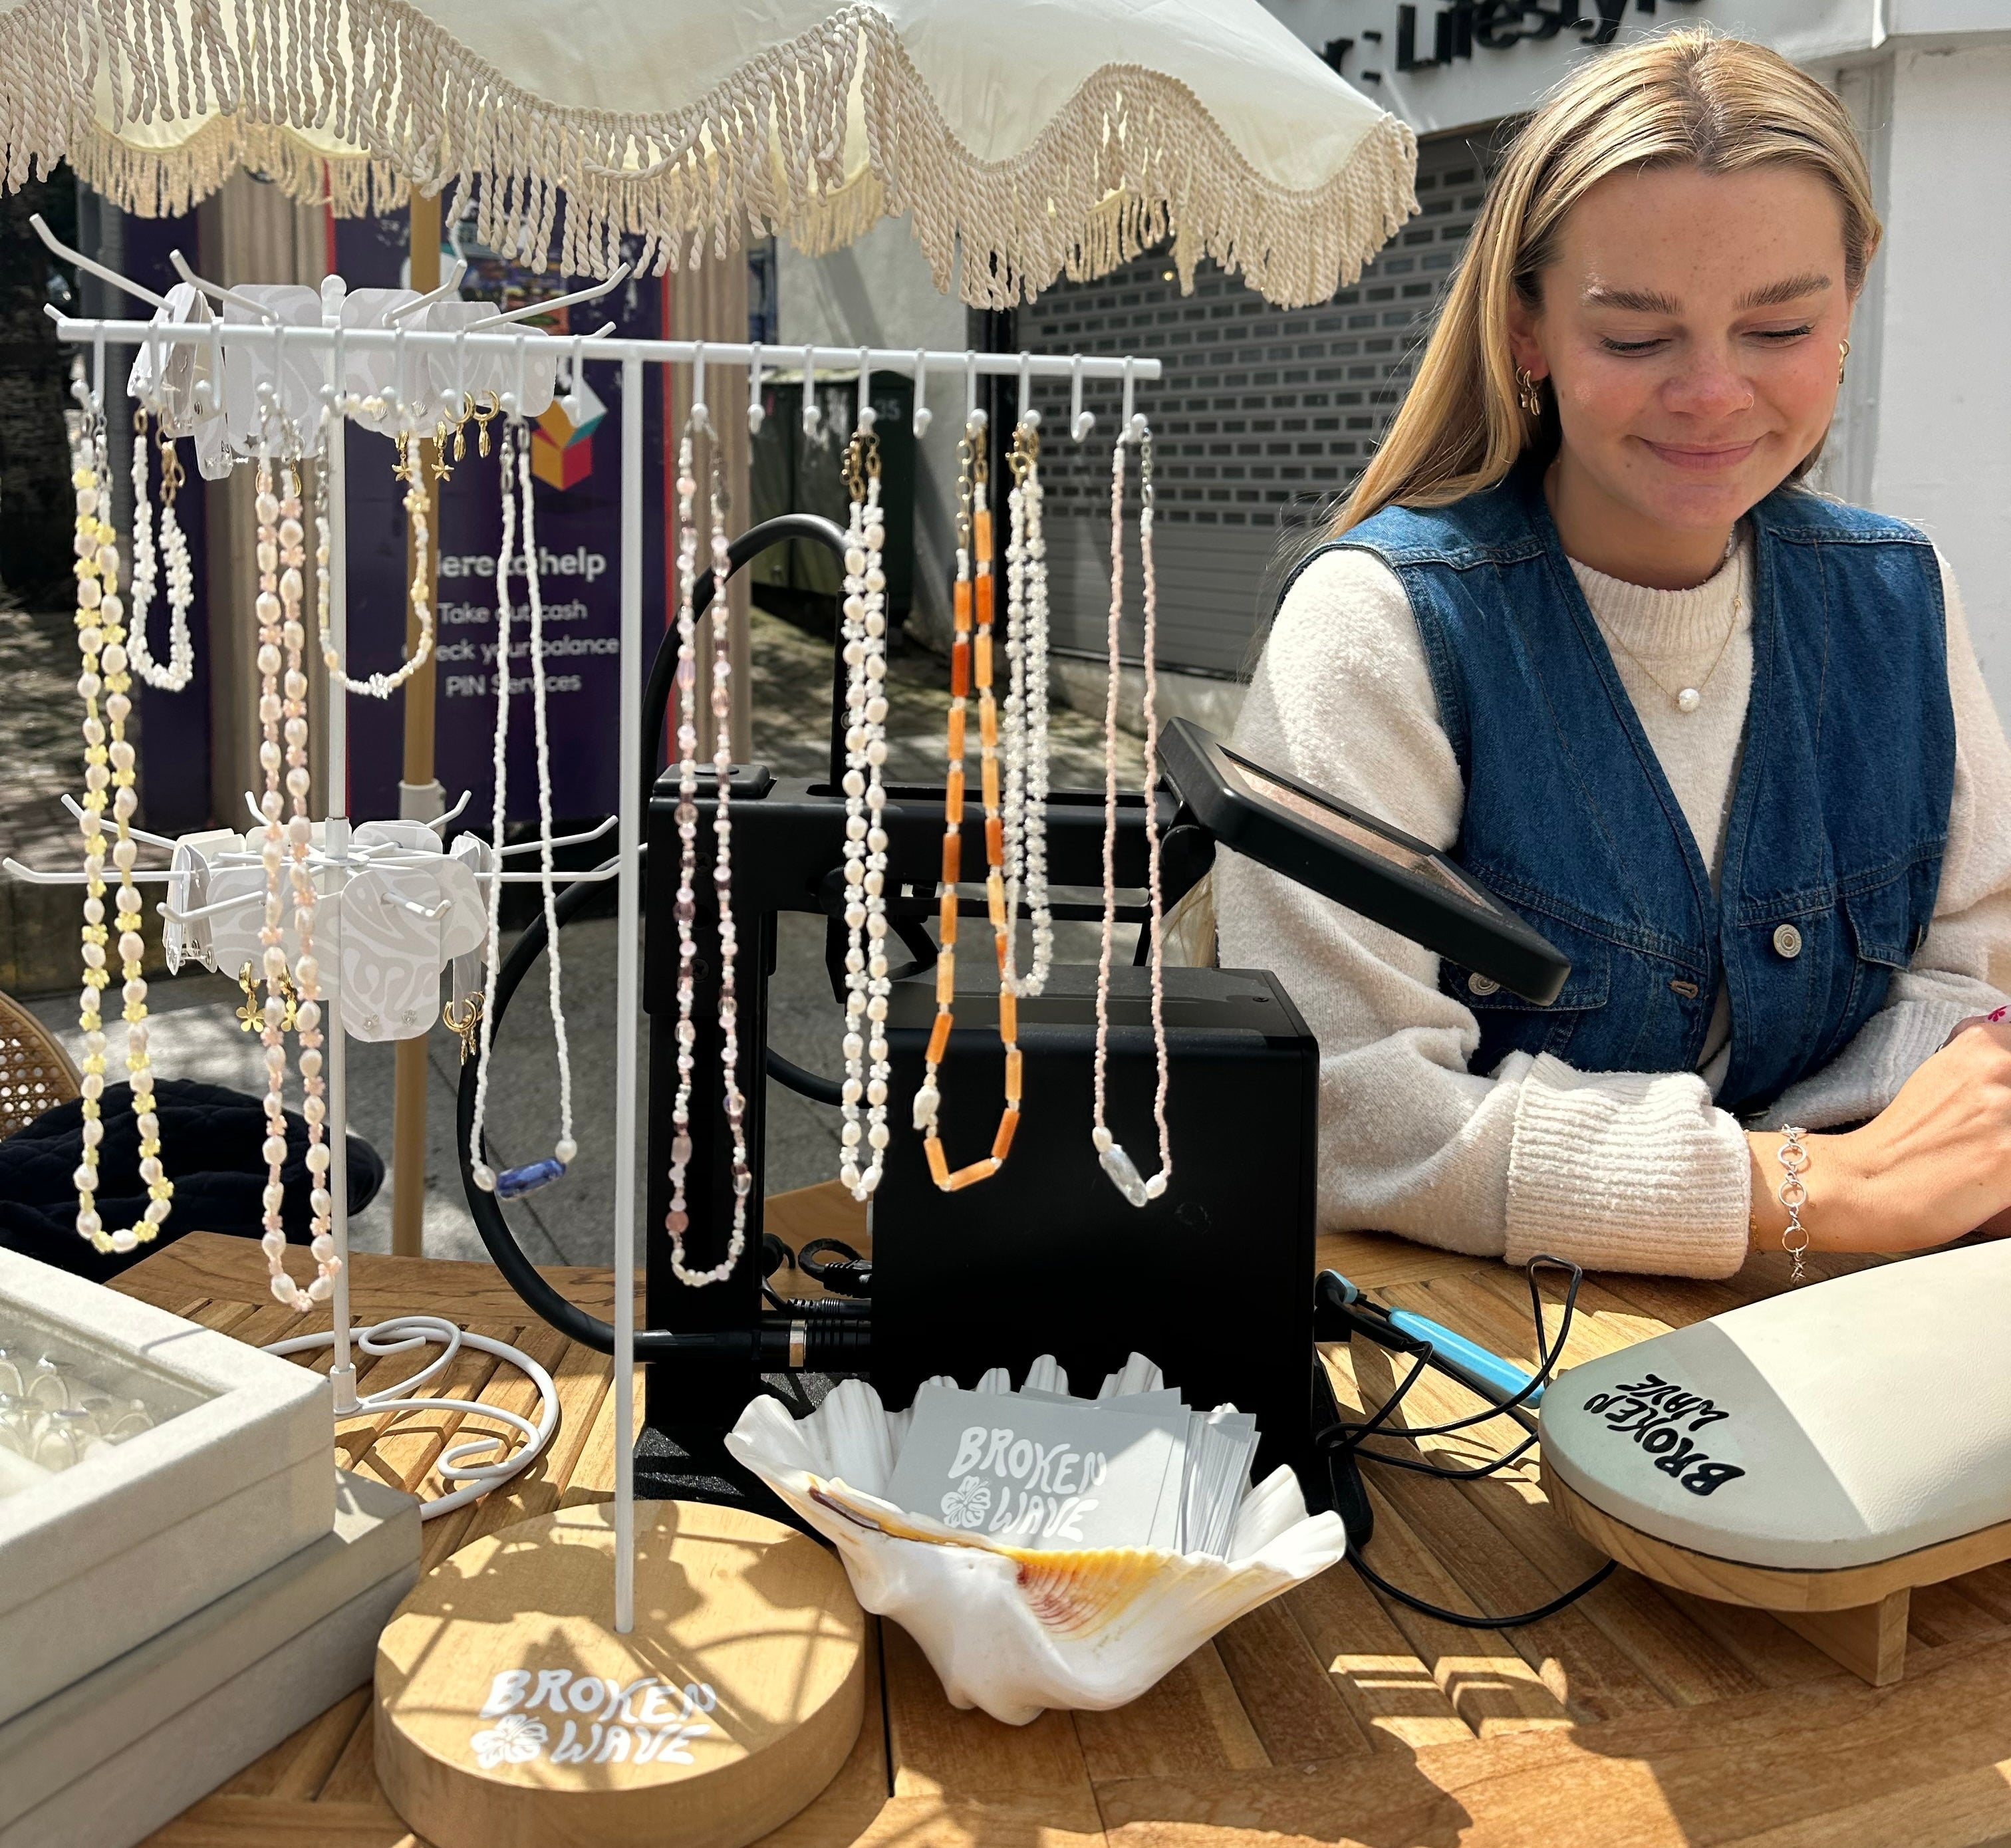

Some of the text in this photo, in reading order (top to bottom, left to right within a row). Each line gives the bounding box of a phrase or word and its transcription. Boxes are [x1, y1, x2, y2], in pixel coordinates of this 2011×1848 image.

[538, 545, 606, 583] help
[436, 602, 491, 625] Take
[540, 598, 589, 621] cash
[479, 640, 531, 666] yur
[445, 674, 487, 698] PIN
[1615, 1373, 1730, 1432] WAVE
[948, 1426, 1107, 1494] BROKEN
[1583, 1393, 1746, 1496] BROKEN
[988, 1486, 1099, 1542] WAVE
[479, 1668, 717, 1724] BROKEN
[550, 1720, 711, 1765] WAVE
